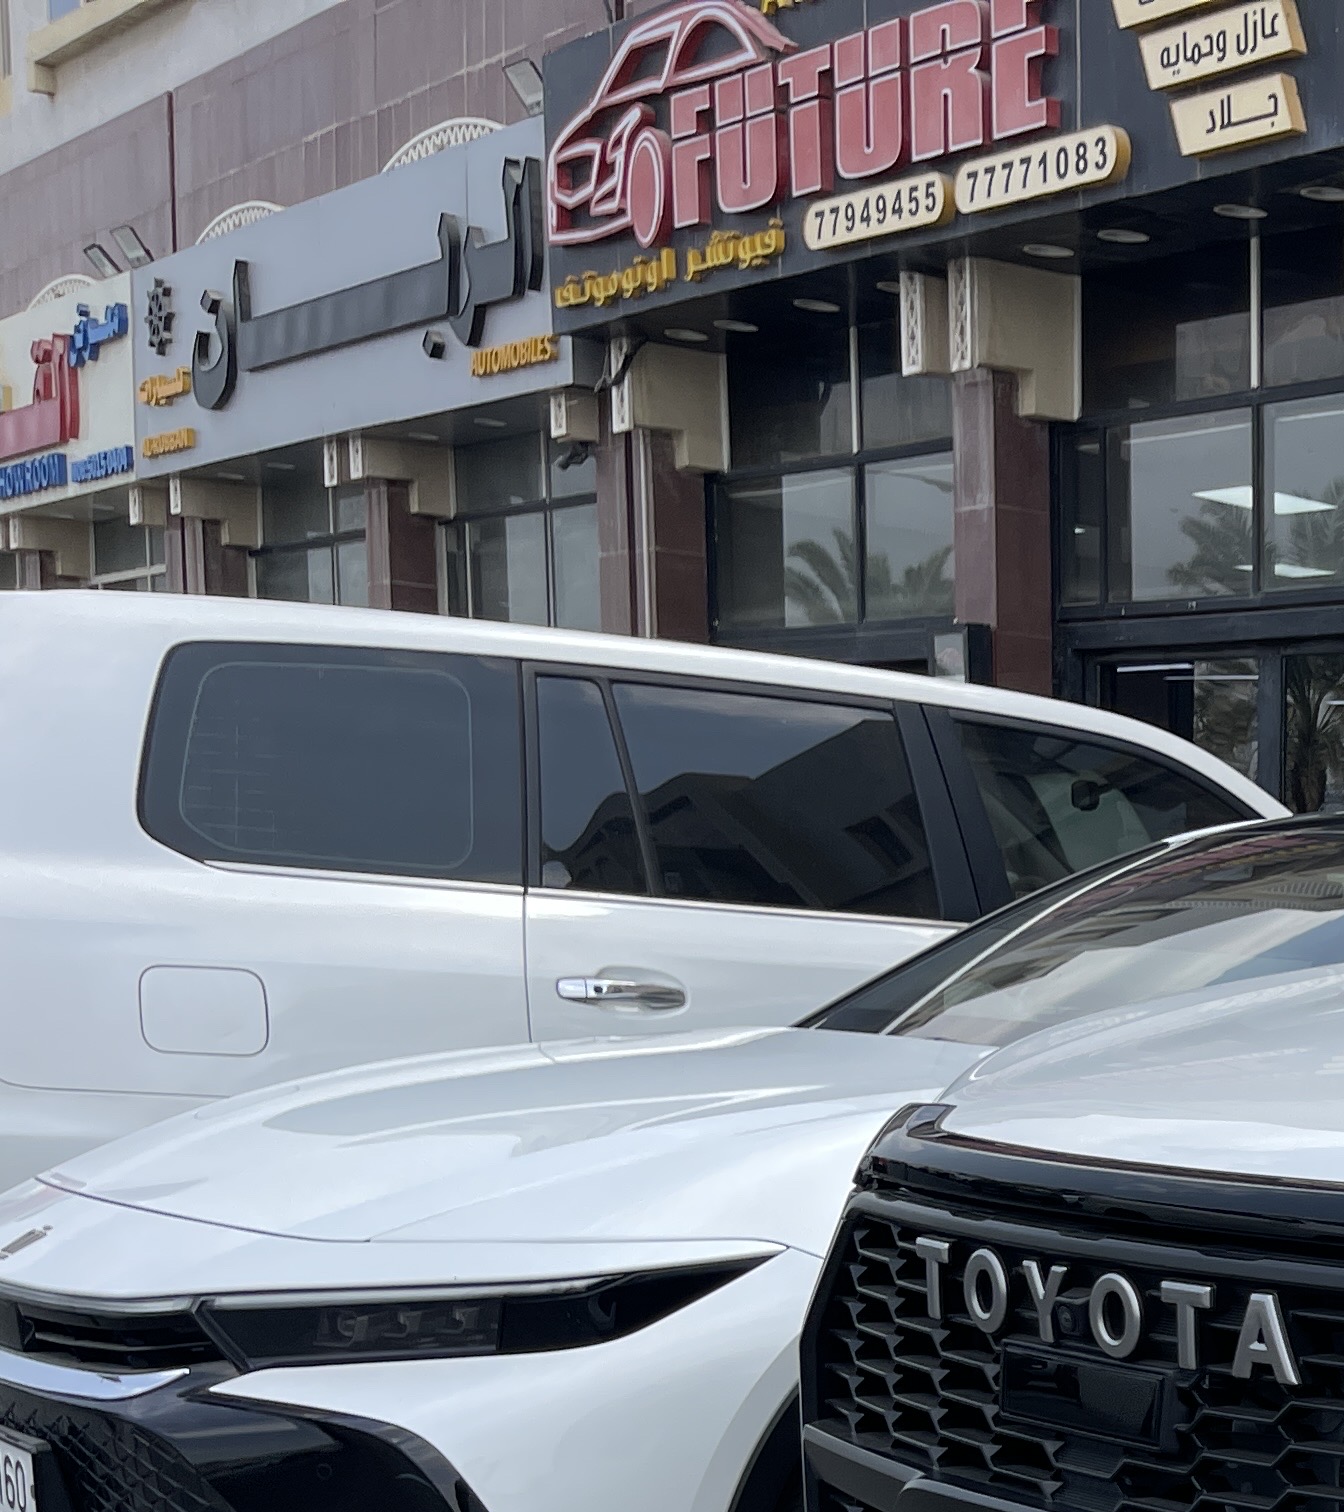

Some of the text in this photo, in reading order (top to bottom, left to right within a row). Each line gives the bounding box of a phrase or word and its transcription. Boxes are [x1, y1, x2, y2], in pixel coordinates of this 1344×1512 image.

[1236, 7, 1280, 56] عازل
[669, 0, 1056, 229] FUTURE
[965, 135, 1108, 203] 77771083
[814, 180, 937, 243] 77949455
[470, 333, 559, 377] AUTOMOBILES
[915, 1236, 1299, 1386] TOYOTA
